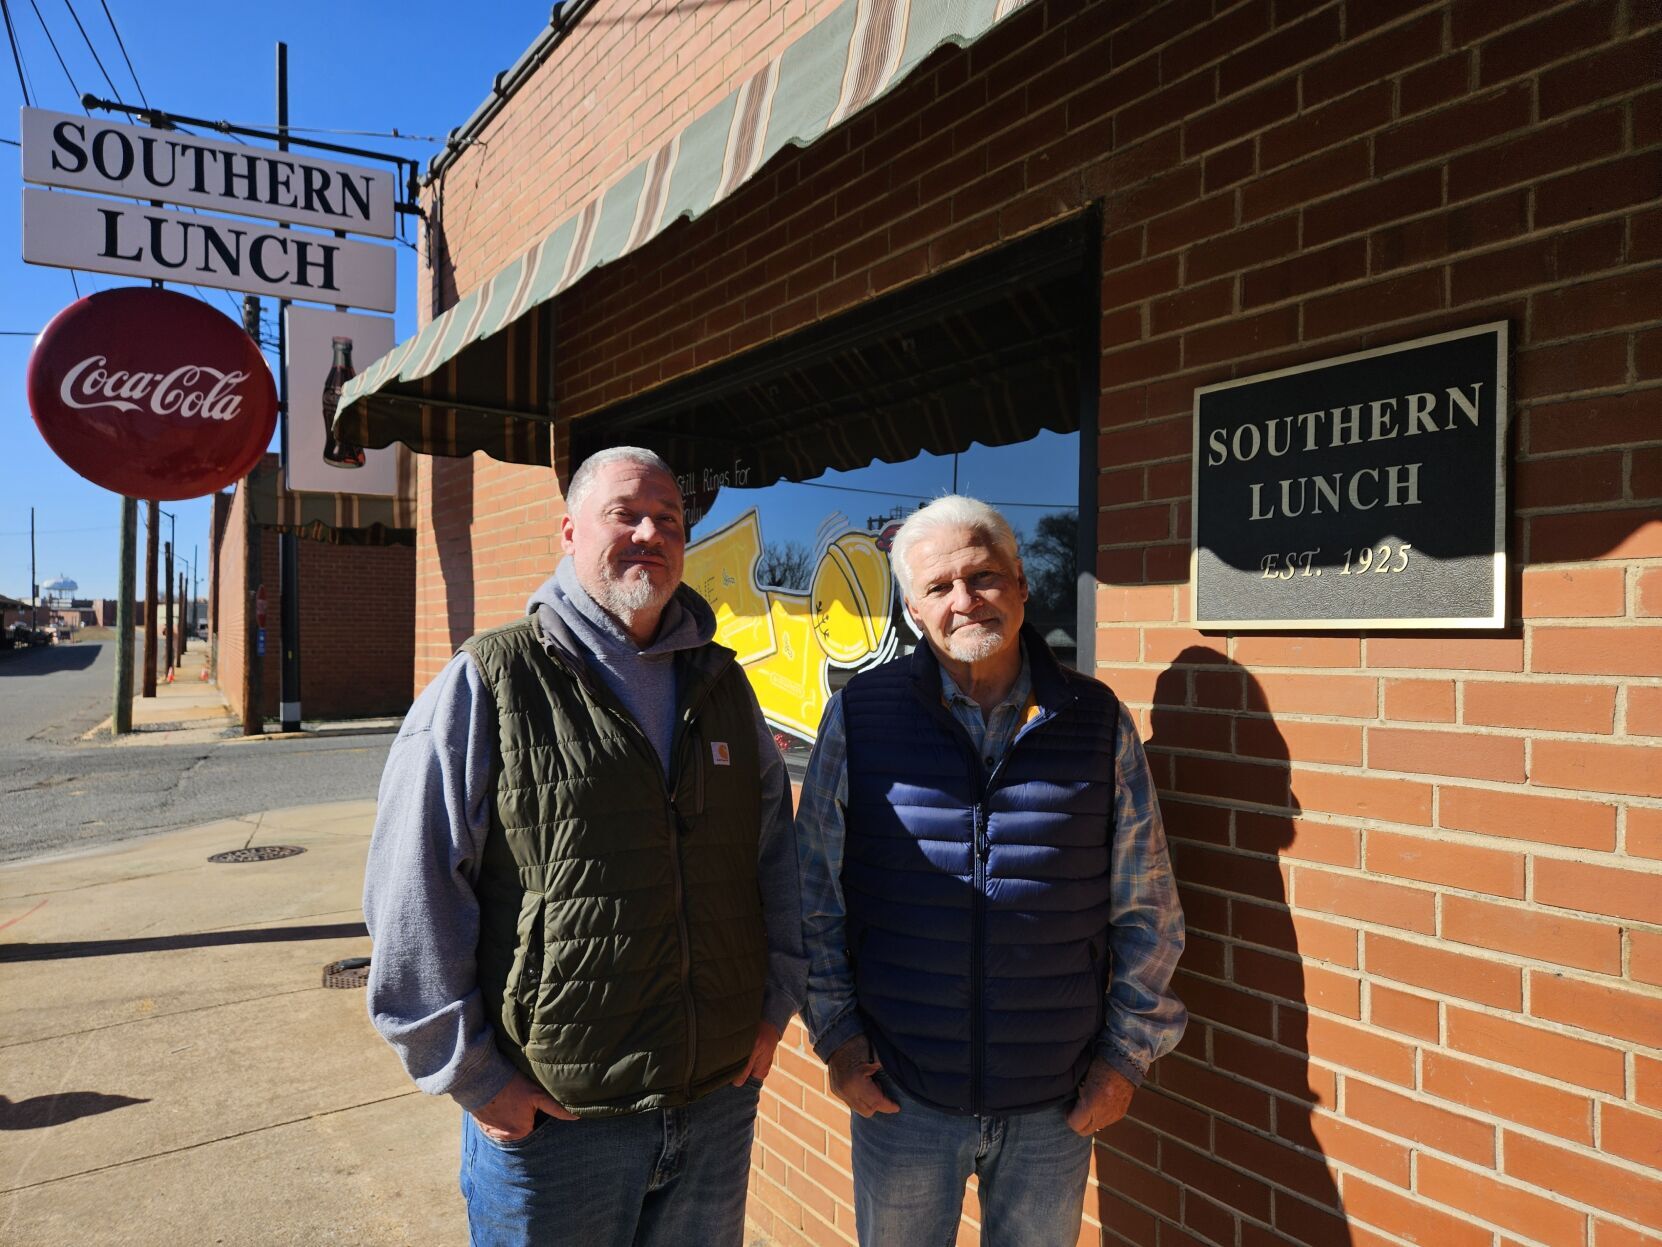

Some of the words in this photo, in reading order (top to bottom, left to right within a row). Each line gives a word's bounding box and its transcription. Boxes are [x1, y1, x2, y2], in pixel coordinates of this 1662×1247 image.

[51, 121, 374, 221] SOUTHERN
[97, 208, 340, 291] LUNCH
[60, 355, 251, 422] Coca-Cola
[1208, 382, 1484, 467] SOUTHERN
[735, 459, 751, 486] For
[1249, 462, 1423, 520] LUNCH
[1260, 547, 1324, 581] EST.
[1340, 543, 1412, 576] 1925
